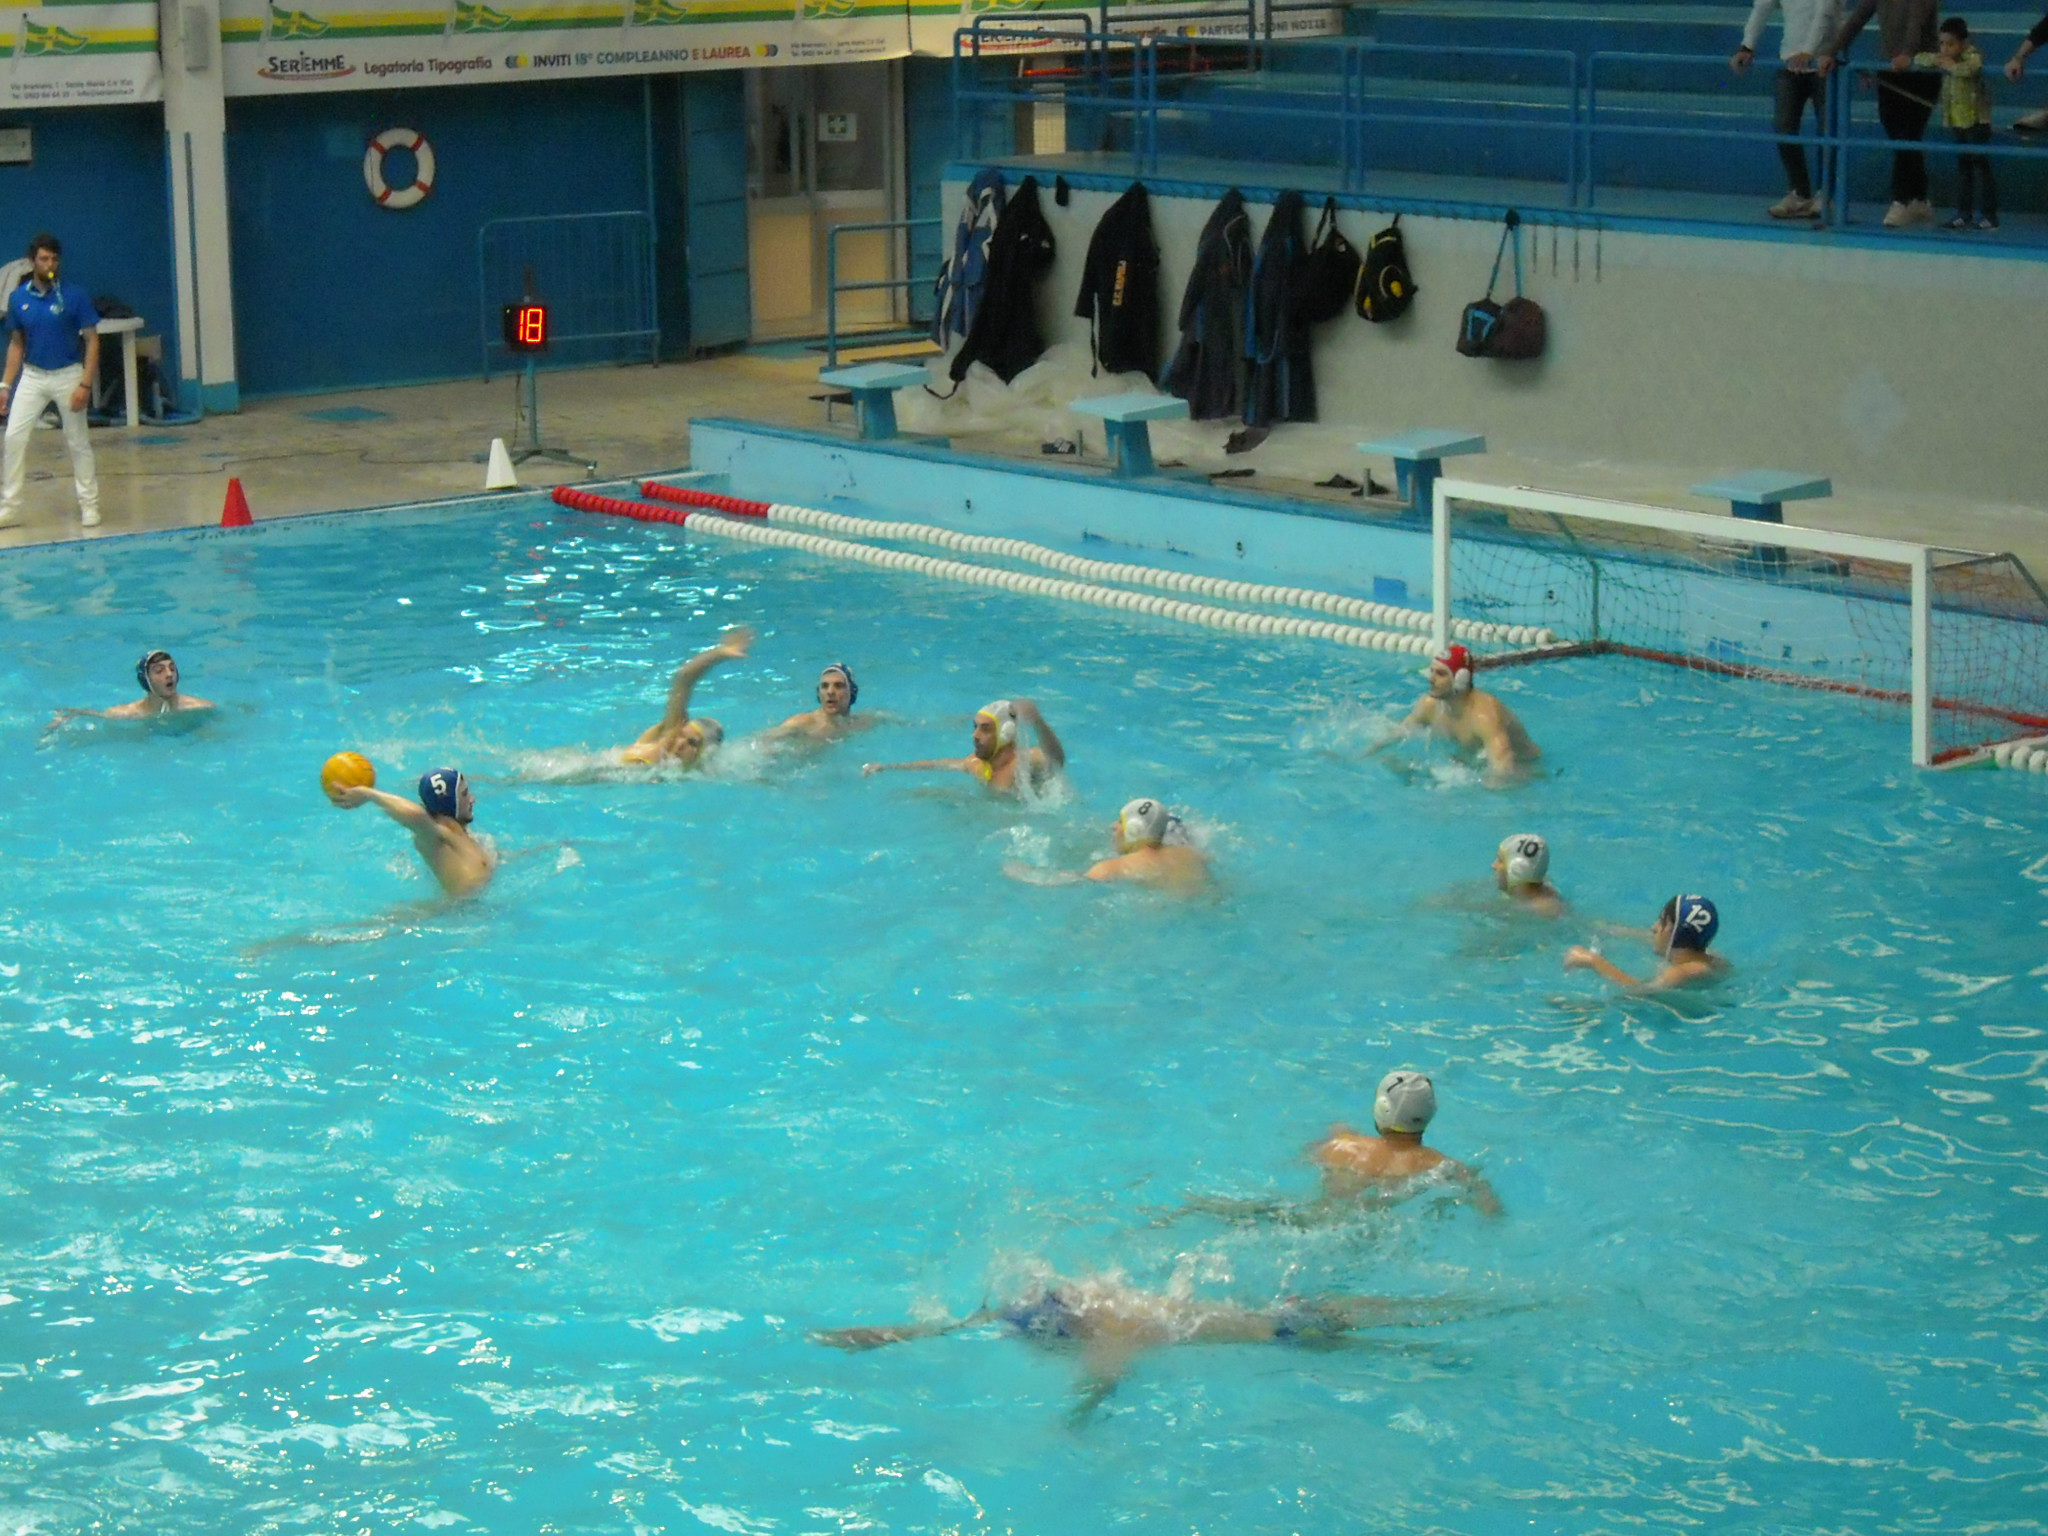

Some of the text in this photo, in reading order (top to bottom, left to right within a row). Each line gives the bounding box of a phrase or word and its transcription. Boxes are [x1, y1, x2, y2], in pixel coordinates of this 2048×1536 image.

[364, 56, 492, 77] Legatoria Tipografia
[533, 53, 571, 68] INVITI
[596, 48, 689, 65] COMPLEANNO
[691, 48, 700, 60] E
[702, 45, 751, 60] LAUREA
[519, 308, 543, 342] 18
[430, 772, 447, 796] 5
[1138, 801, 1152, 816] 8
[1516, 838, 1539, 858] 10
[1685, 904, 1712, 933] 12
